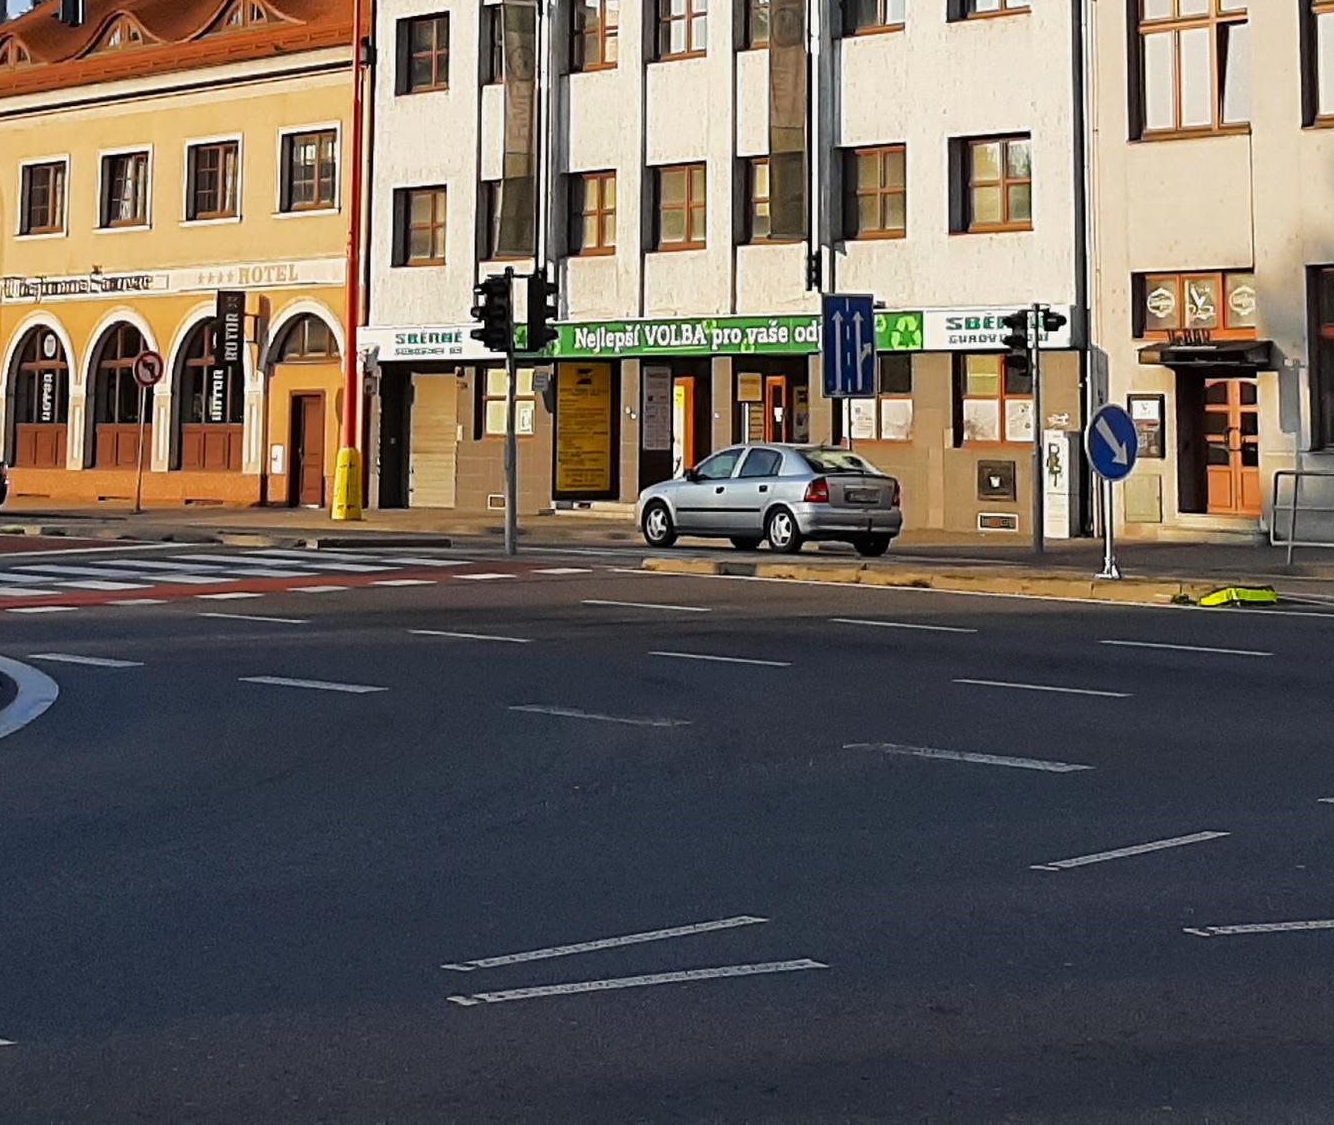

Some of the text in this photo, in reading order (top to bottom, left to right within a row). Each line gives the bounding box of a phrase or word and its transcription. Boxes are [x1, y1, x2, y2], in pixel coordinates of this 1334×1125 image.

[238, 264, 299, 285] HOTEL
[574, 324, 640, 353] Nejlepší
[644, 324, 707, 347] VOLBA
[711, 325, 740, 350] pro
[746, 320, 788, 343] vaše
